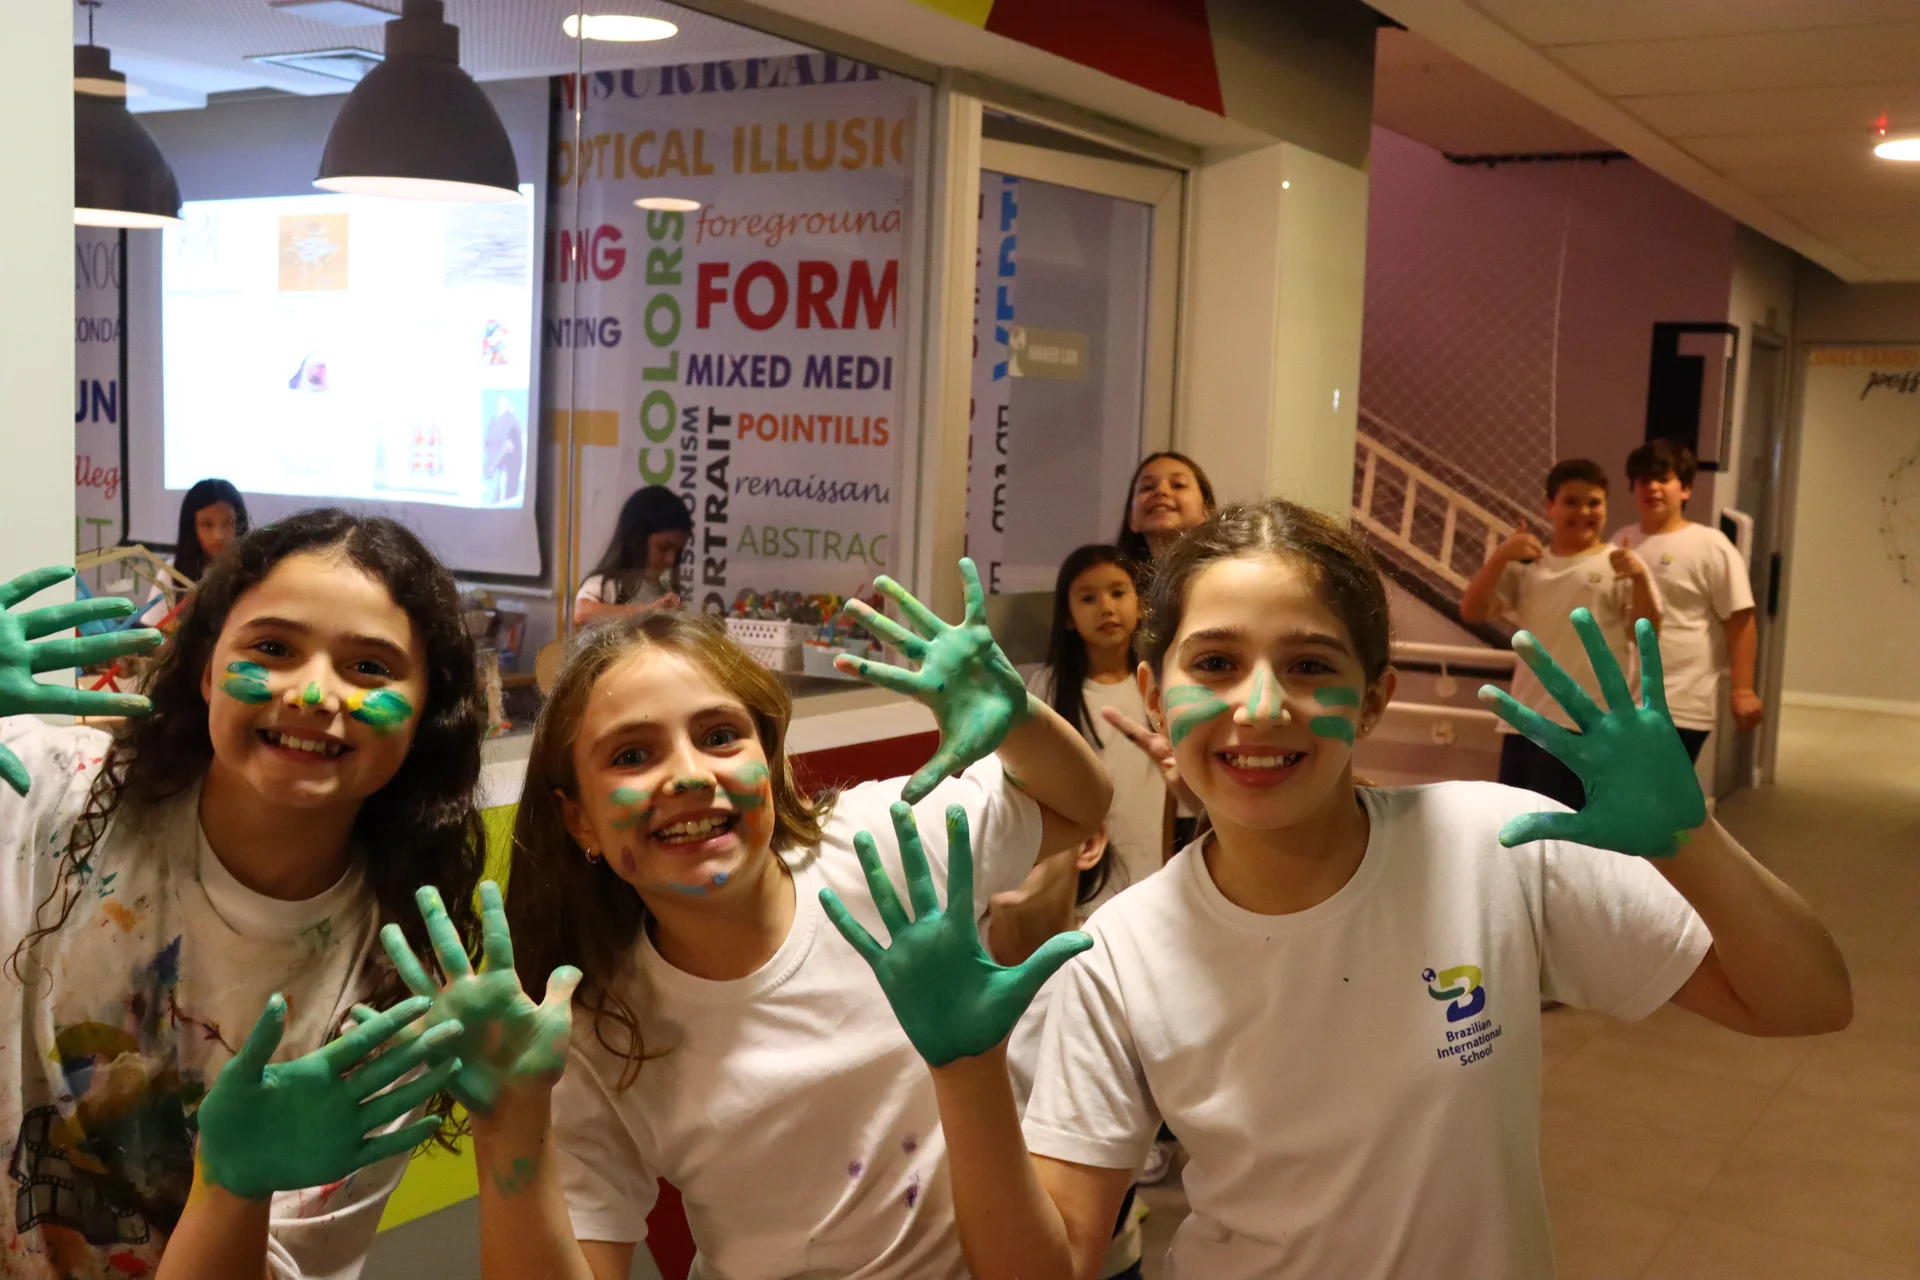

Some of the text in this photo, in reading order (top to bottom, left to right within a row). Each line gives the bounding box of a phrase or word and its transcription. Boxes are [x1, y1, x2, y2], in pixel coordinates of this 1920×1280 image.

[696, 259, 900, 331] FORM
[638, 208, 685, 486] COLORS
[686, 353, 893, 391] MIXED MEDI
[737, 411, 890, 448] POINTILIS
[734, 473, 890, 505] renaissan
[736, 525, 888, 566] ABSTRAC
[1437, 1025, 1502, 1059] International
[1446, 1019, 1492, 1043] Brazilian
[1460, 1043, 1493, 1067] School
